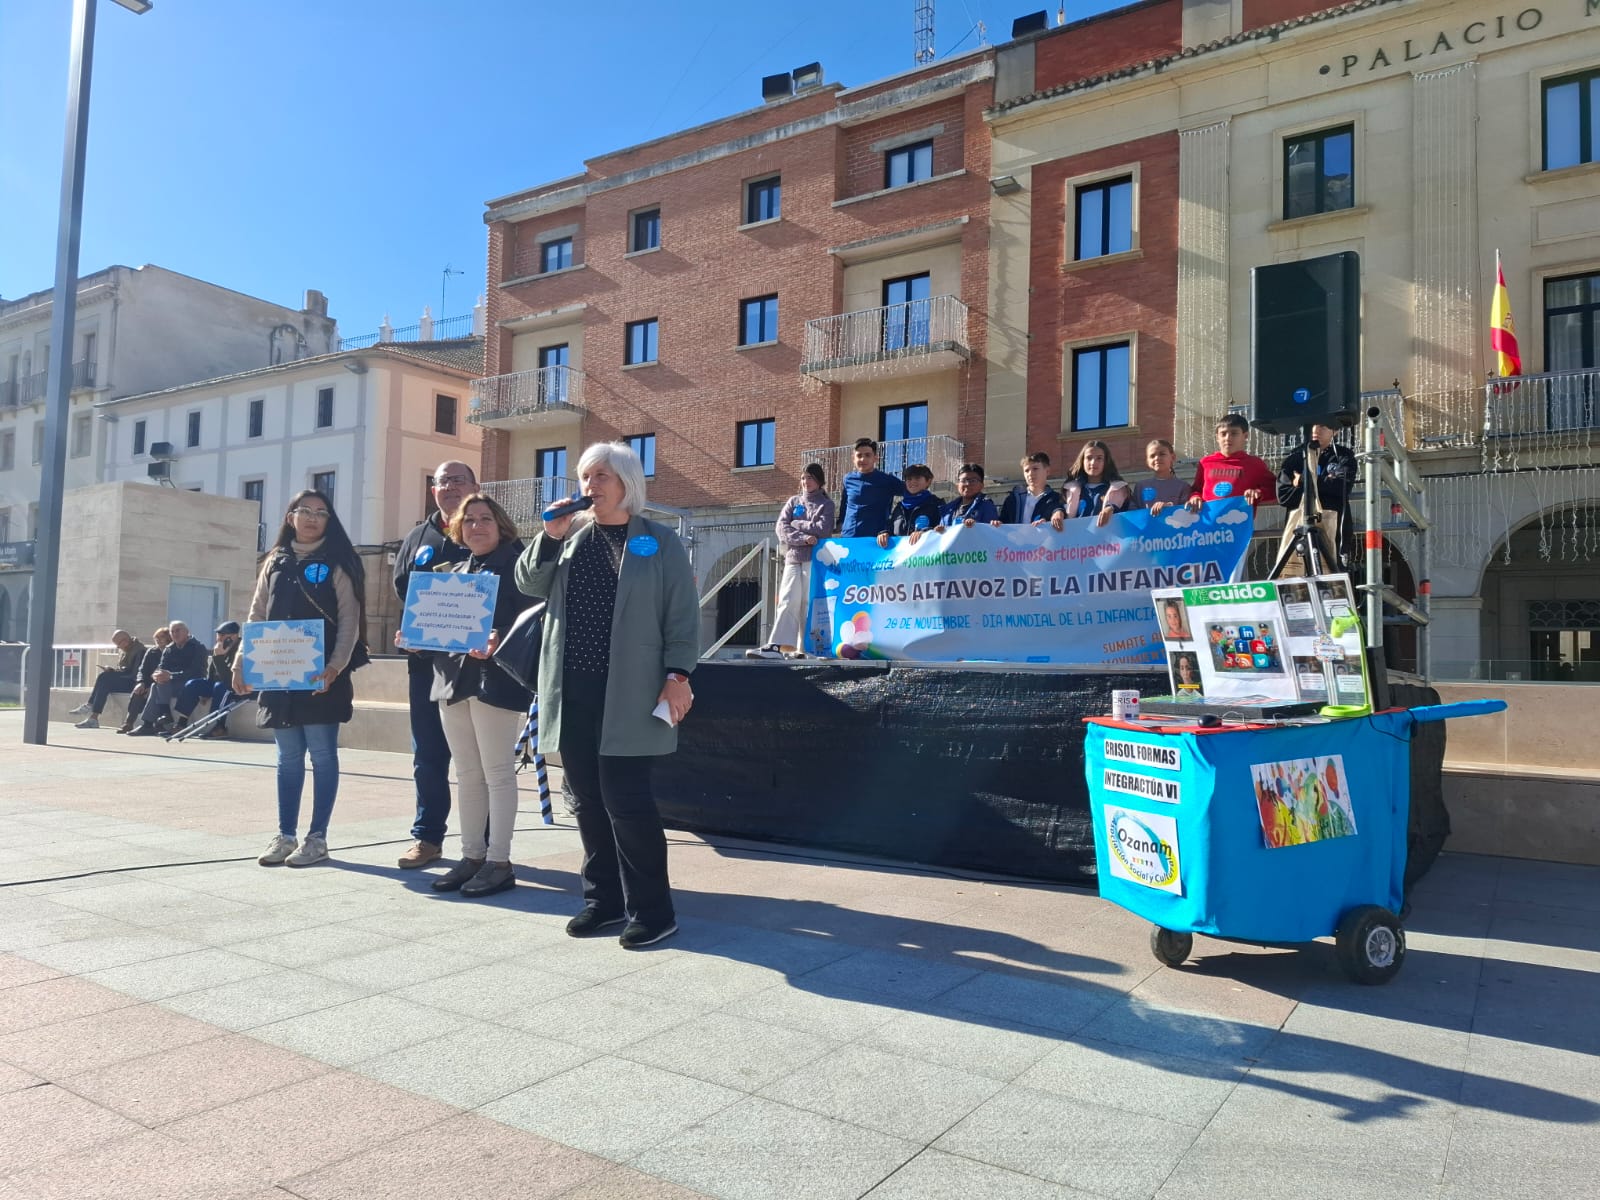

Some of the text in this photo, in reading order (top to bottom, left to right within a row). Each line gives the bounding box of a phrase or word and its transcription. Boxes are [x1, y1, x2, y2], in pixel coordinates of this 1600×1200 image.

[1340, 8, 1543, 77] PALACIO
[1131, 527, 1235, 553] #SomosInfancia
[902, 550, 988, 568] #SomosAltavoces
[843, 561, 1224, 604] SOMOS ALTAVOZ DE LA INFANCIA
[1208, 584, 1267, 601] cuido
[900, 617, 913, 629] DE
[914, 614, 971, 630] NOVIEMBRE
[1005, 612, 1056, 628] MUNDIAL
[1059, 612, 1075, 626] DE
[1078, 611, 1093, 625] LA
[1102, 634, 1147, 654] SUMATE
[1105, 741, 1176, 765] CRISOL FORMAS
[1104, 770, 1178, 800] INTEGRACTÚA VI
[1117, 827, 1172, 857] Ozanam
[1129, 863, 1149, 881] Social
